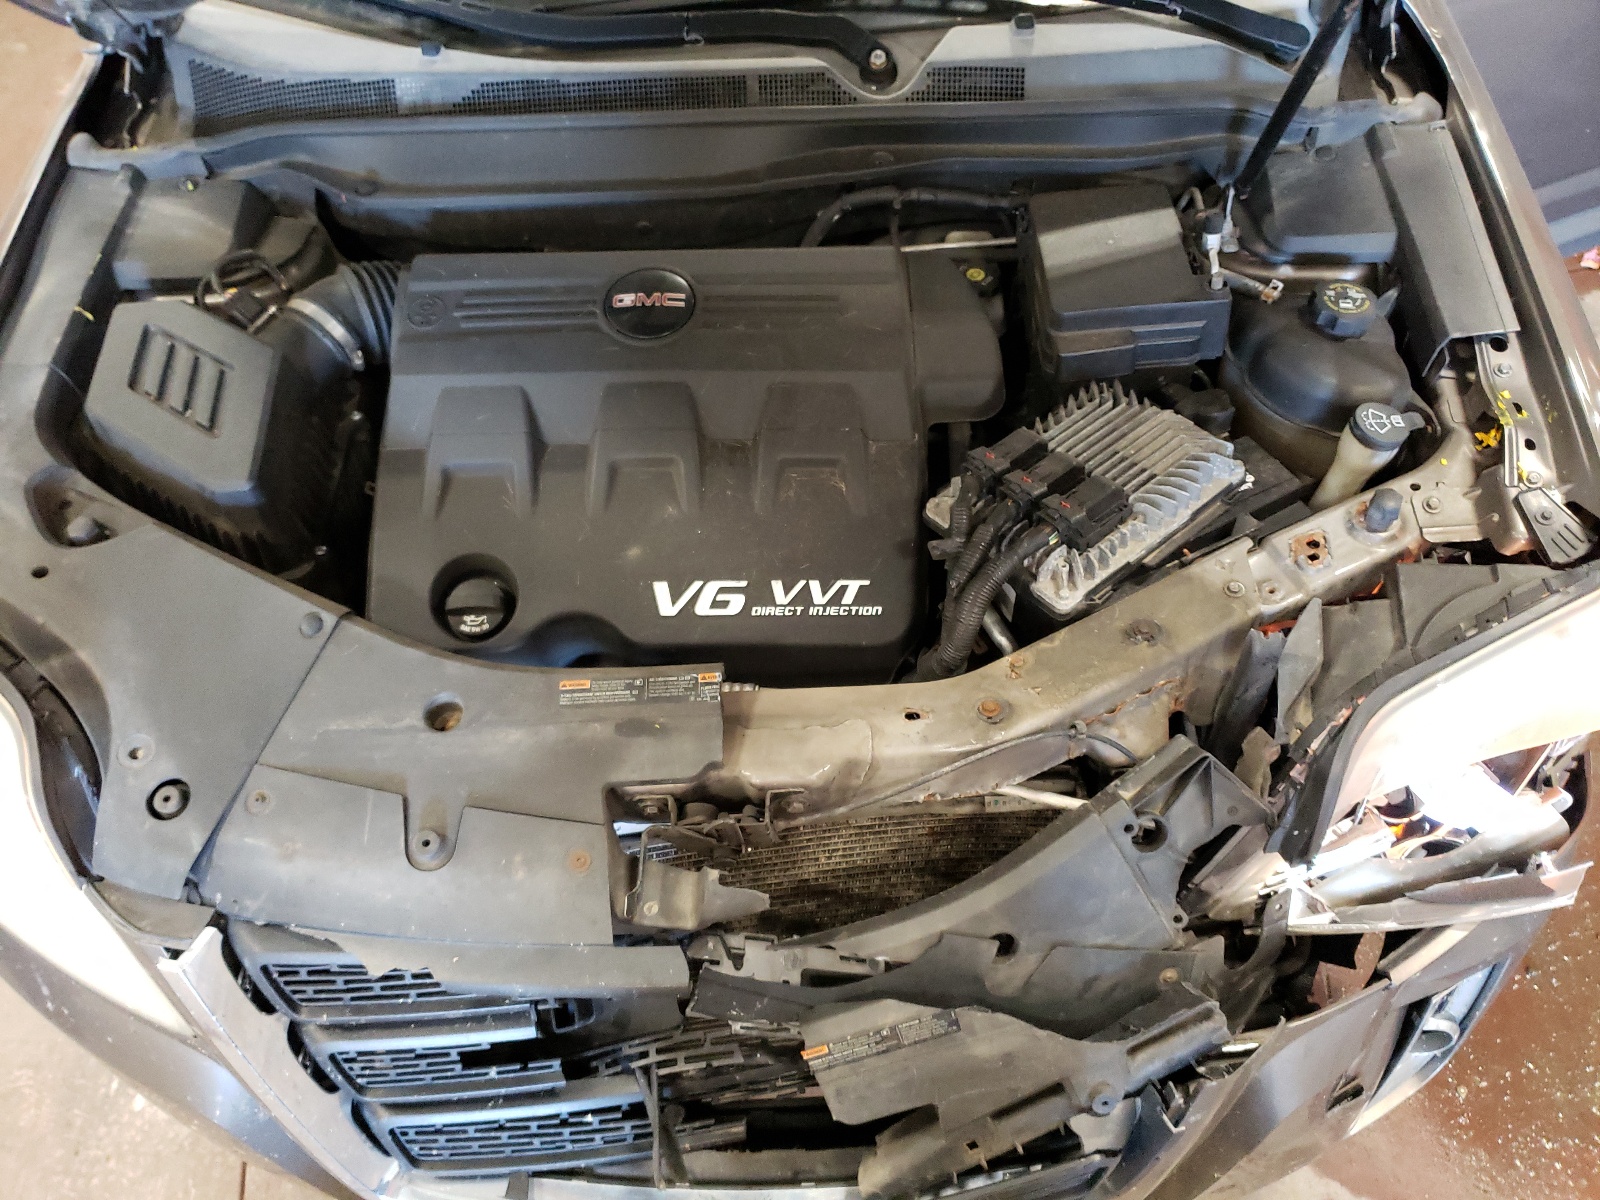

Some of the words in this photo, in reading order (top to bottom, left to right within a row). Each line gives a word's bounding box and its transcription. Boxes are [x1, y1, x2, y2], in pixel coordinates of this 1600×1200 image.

[612, 292, 686, 308] GMC
[652, 580, 748, 617] V6
[771, 579, 871, 605] VVT
[751, 606, 804, 616] DIRECT
[809, 606, 883, 616] INJECTION
